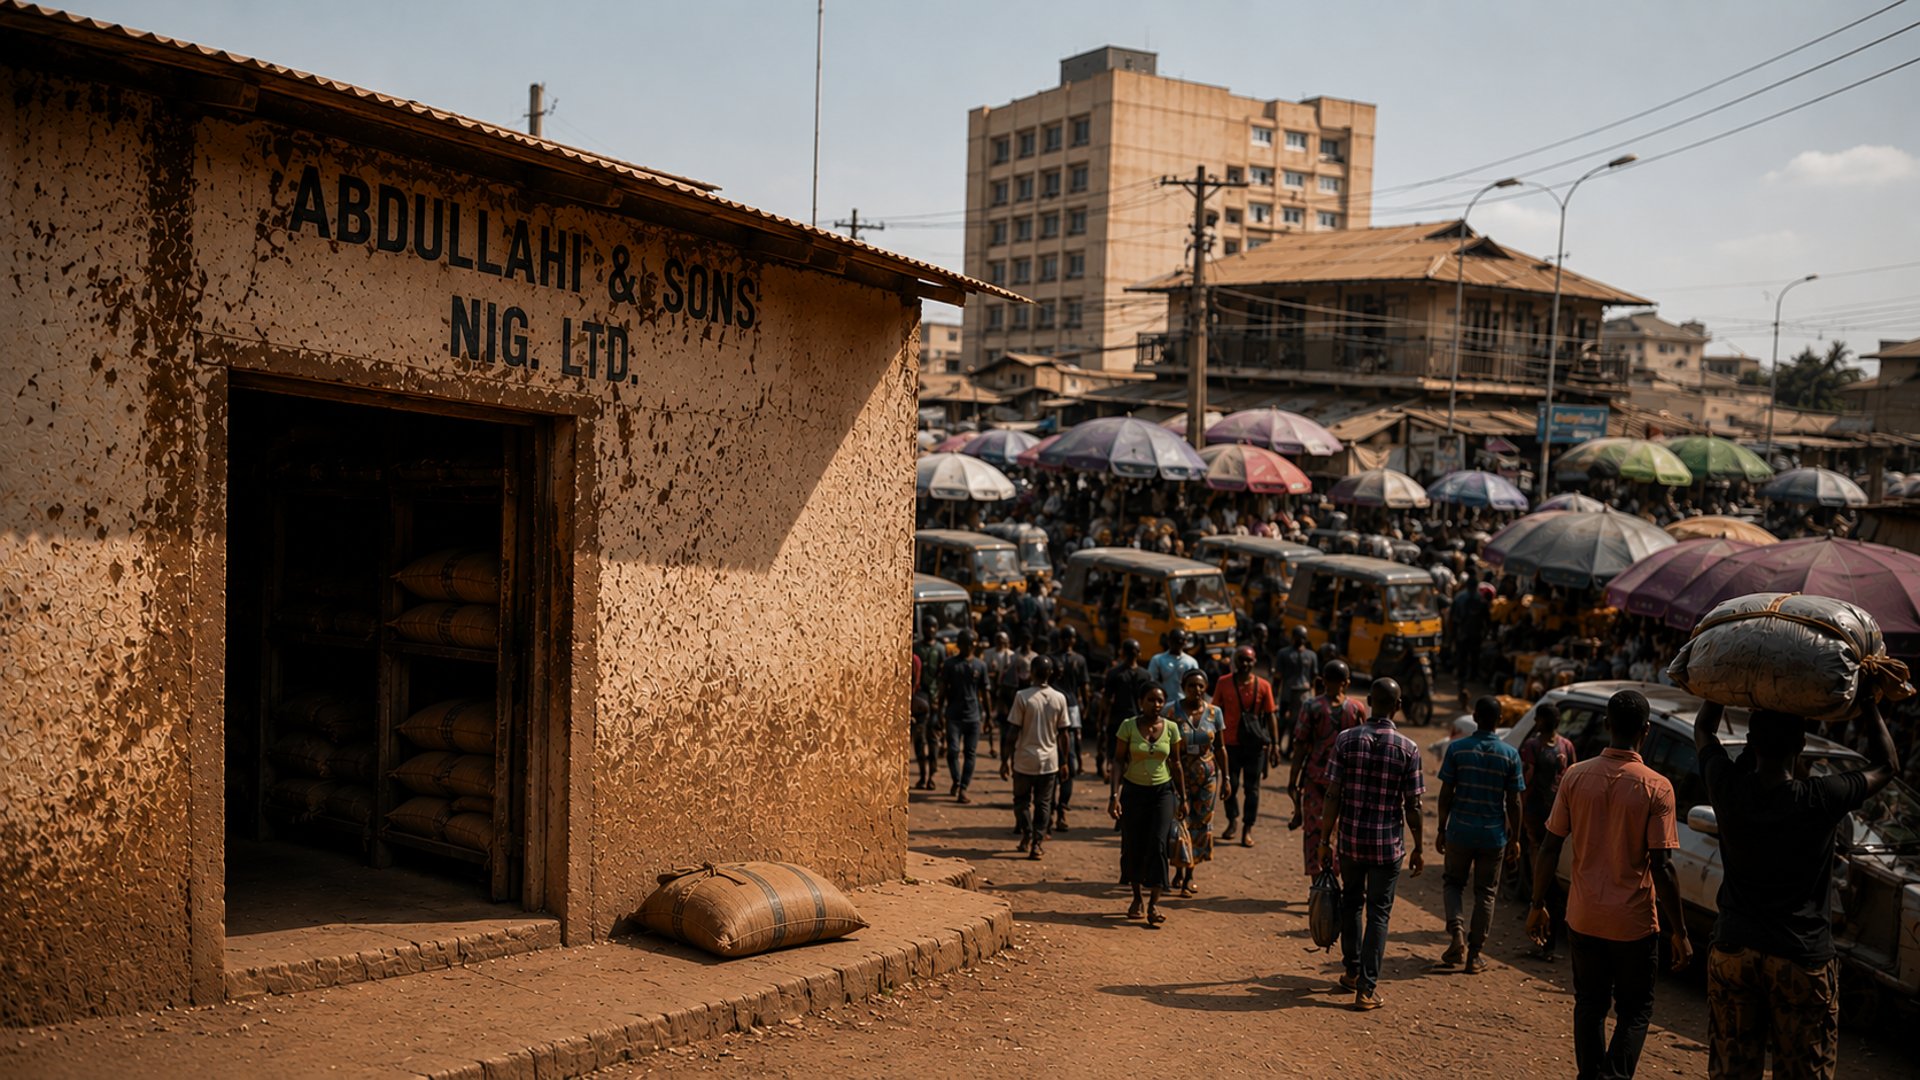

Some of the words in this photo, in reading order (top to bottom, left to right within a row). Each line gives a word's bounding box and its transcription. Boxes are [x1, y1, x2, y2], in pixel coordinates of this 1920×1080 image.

[289, 165, 581, 292] ABDULLAHI
[608, 245, 637, 303] &
[663, 257, 756, 330] SONS
[451, 295, 539, 370] NIG.
[562, 317, 638, 385] LTD.
